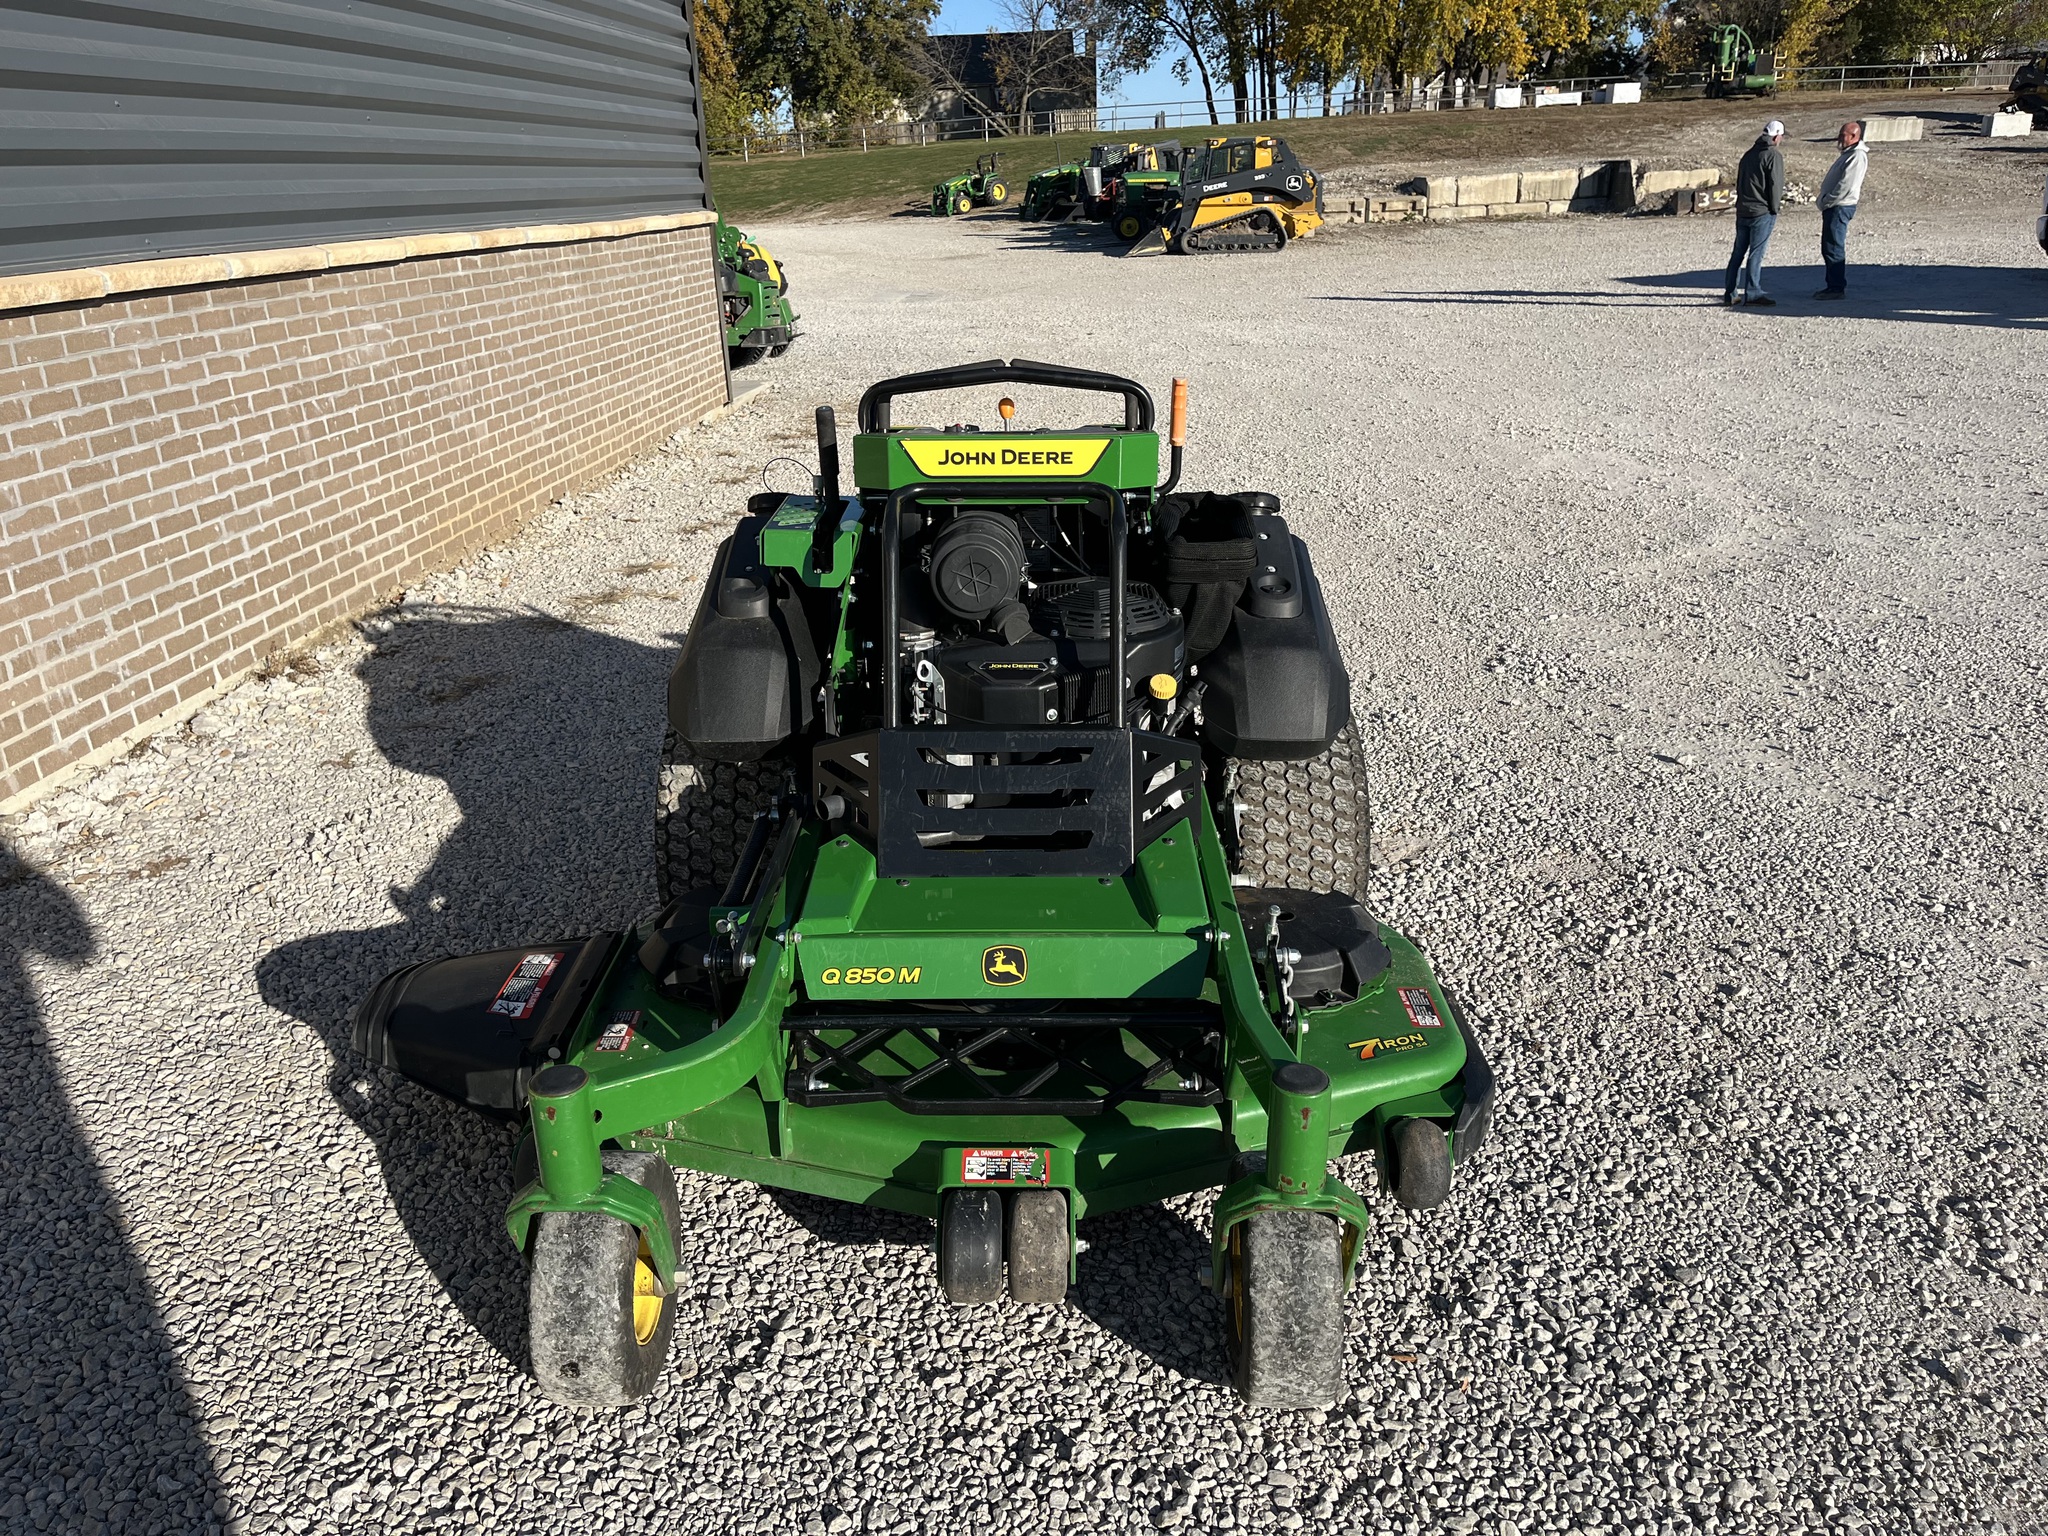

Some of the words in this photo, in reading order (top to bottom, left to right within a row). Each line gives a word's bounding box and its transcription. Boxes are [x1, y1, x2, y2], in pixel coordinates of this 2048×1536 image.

[1203, 181, 1228, 192] DEERE
[938, 449, 996, 465] JOHN
[1001, 449, 1074, 465] DEERE
